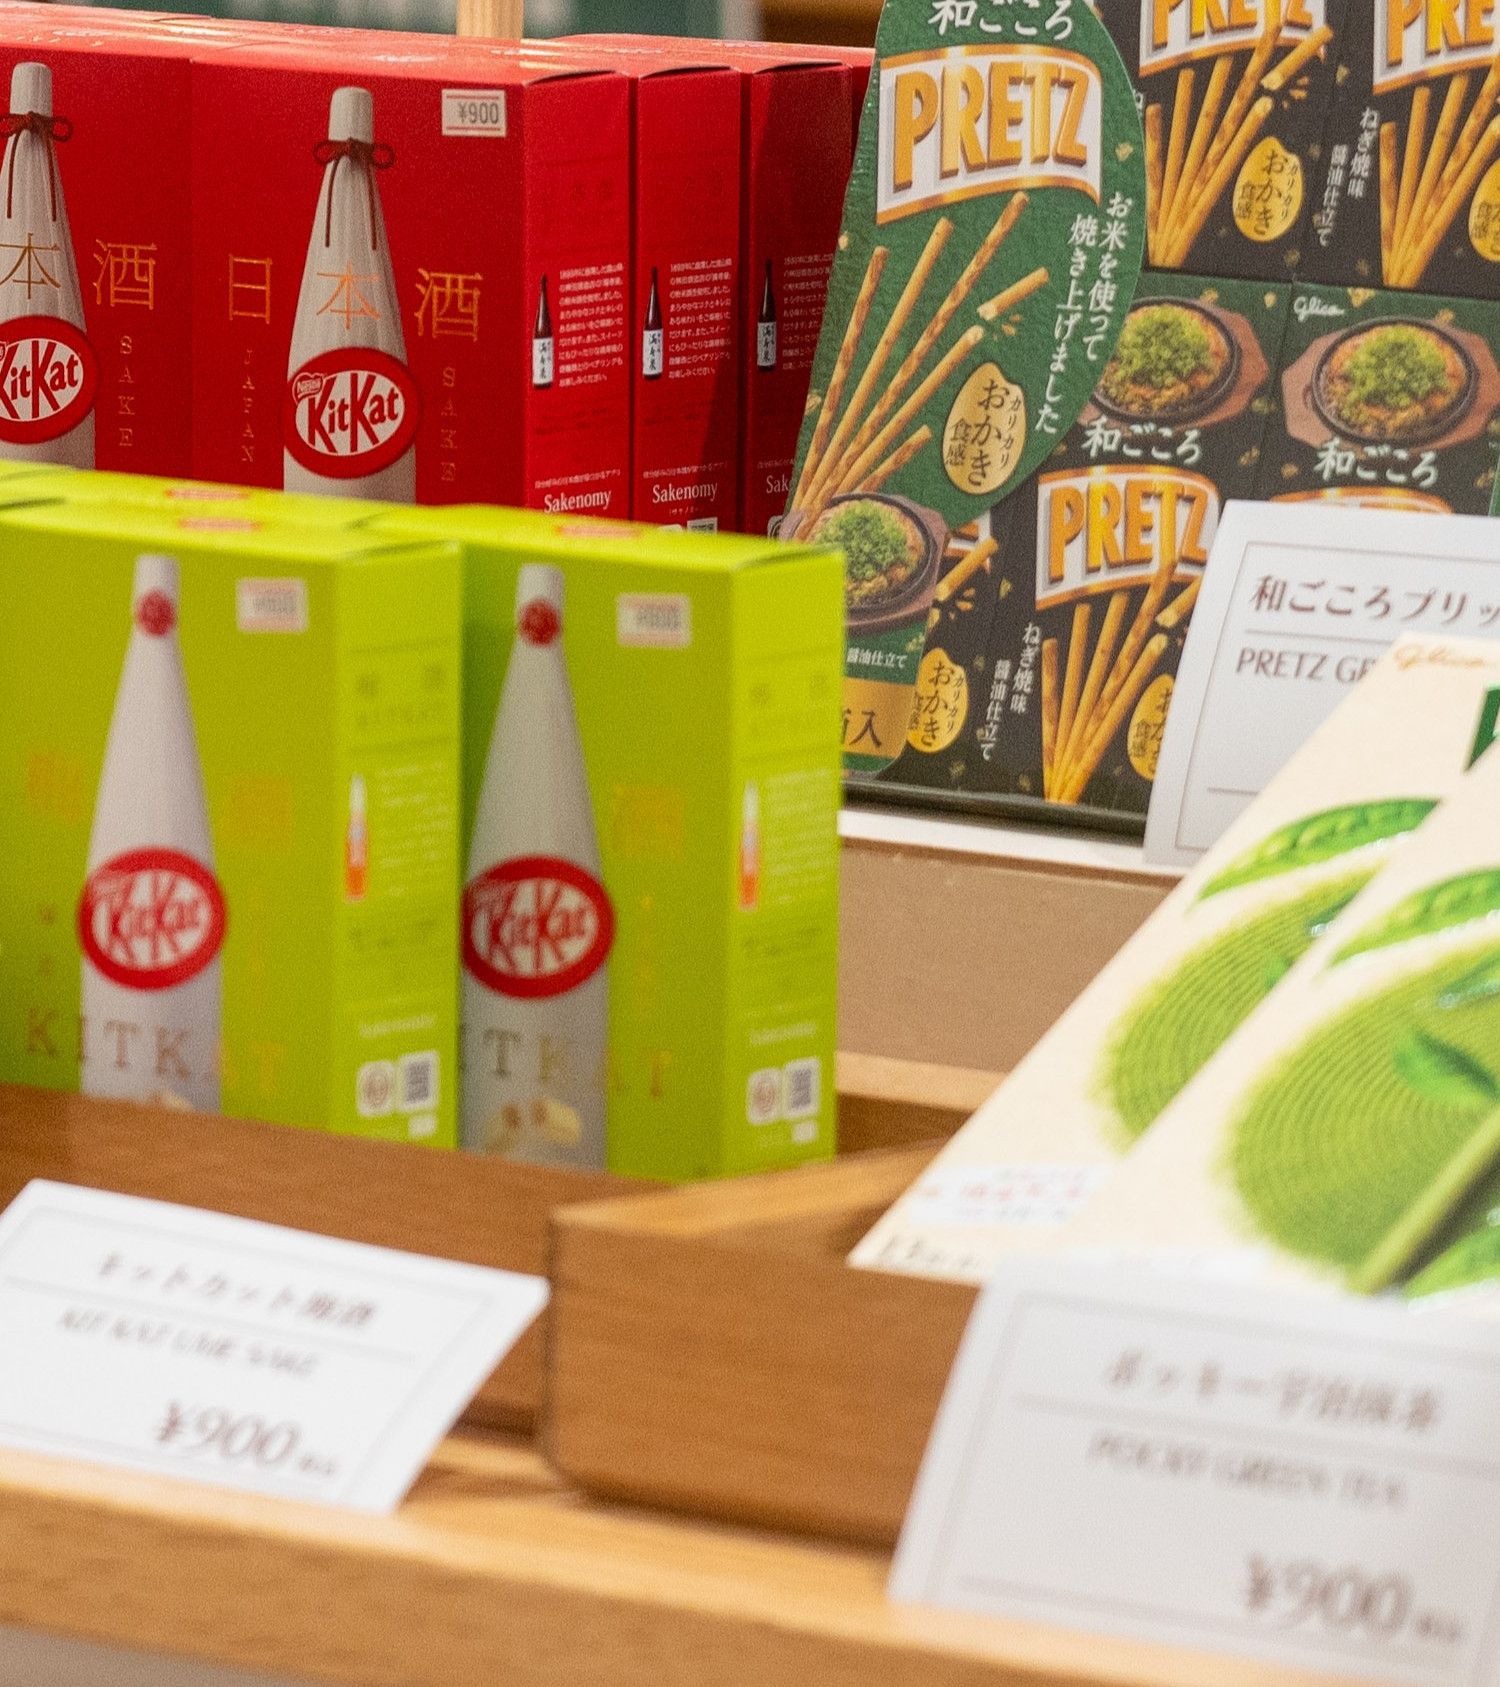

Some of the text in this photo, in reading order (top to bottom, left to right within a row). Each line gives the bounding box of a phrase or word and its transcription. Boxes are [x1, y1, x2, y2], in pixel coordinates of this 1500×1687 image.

[459, 102, 499, 124] ¥900
[892, 59, 1090, 193] PRETZ
[228, 254, 483, 342] 日本酒
[1082, 192, 1133, 361] お米を使って
[1035, 213, 1097, 434] 焼き上げました
[307, 370, 399, 454] KitKat
[967, 380, 1008, 486] おかき
[544, 489, 612, 514] Sakenomy
[652, 482, 718, 506] Sakenomy
[1050, 476, 1210, 590] PRETZ
[1235, 647, 1327, 681] PRETZ
[158, 1399, 297, 1465] ¥900
[1245, 1551, 1412, 1640] ¥900
